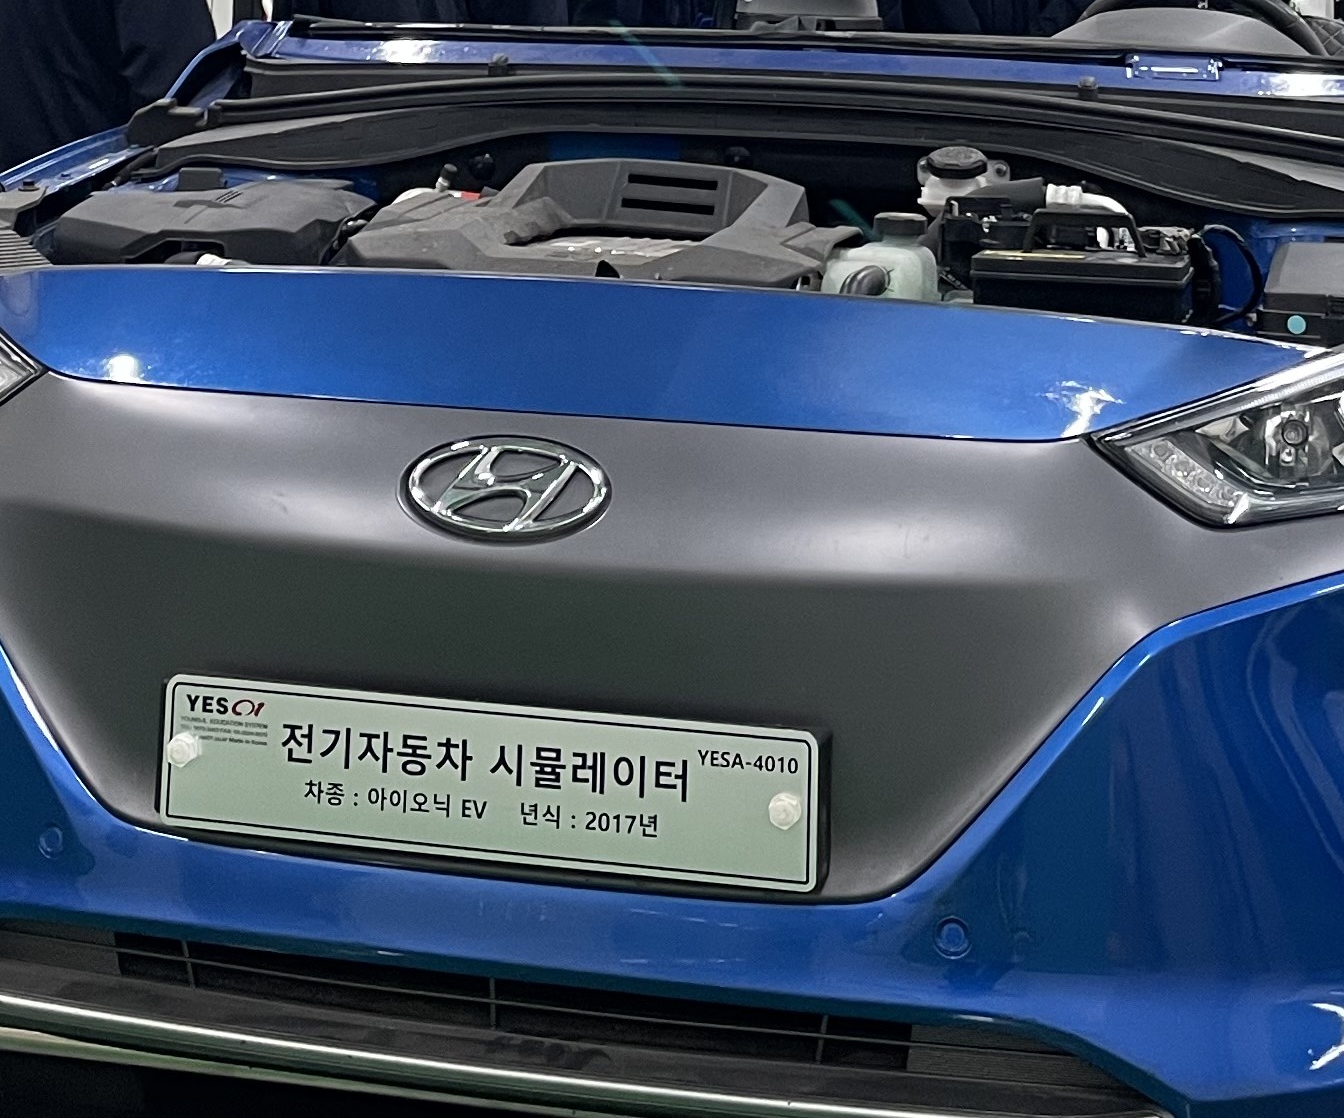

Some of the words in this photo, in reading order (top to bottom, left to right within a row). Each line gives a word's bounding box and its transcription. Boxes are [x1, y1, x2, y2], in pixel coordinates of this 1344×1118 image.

[281, 723, 473, 781] 전기자동차
[489, 744, 688, 803] 시뮬레이터
[697, 749, 799, 774] YESA-4010
[304, 780, 345, 807] 차종
[367, 787, 451, 819] 아이오닉
[461, 798, 487, 819] EV
[520, 802, 561, 830] 년식
[585, 812, 658, 838] 2017년
